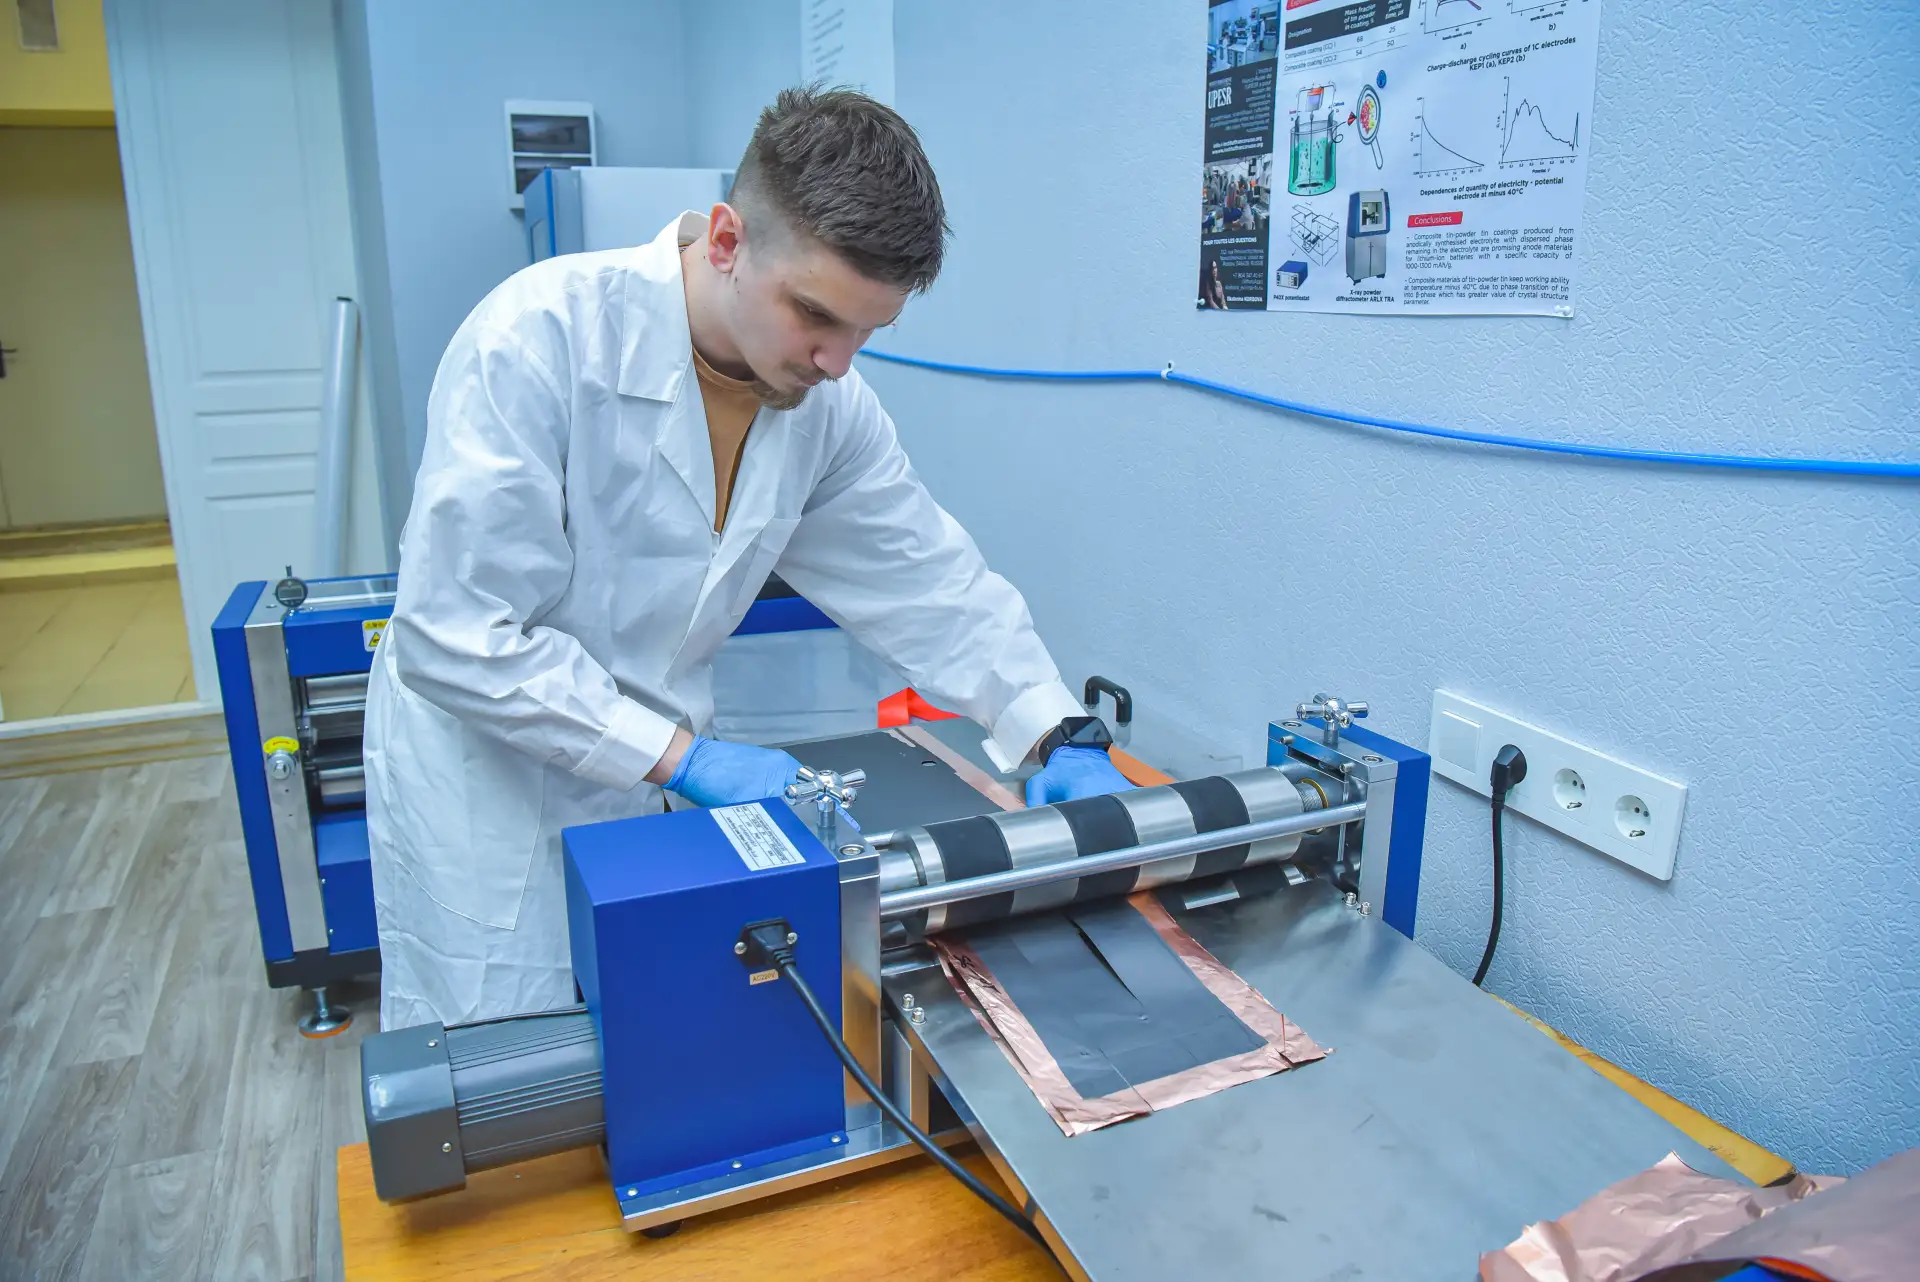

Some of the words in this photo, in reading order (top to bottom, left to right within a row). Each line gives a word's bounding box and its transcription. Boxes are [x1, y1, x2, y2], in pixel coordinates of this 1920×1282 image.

[1358, 4, 1376, 13] fraction
[1359, 11, 1375, 20] powder
[1285, 50, 1306, 59] Composite
[1307, 46, 1322, 54] coating
[1427, 56, 1477, 72] Charge-discharge
[1479, 52, 1500, 62] cycling
[1502, 48, 1522, 57] curves
[1532, 42, 1539, 51] 1C
[1541, 37, 1576, 49] electrodes
[1498, 56, 1514, 65] KEP2
[1516, 55, 1525, 63] (b)
[1285, 63, 1306, 71] Composite
[1307, 59, 1322, 67] coating
[1208, 86, 1232, 109] UPESR
[1420, 186, 1457, 196] Dependences
[1466, 184, 1488, 193] quantity
[1498, 180, 1528, 188] electricity
[1535, 177, 1563, 186] potential
[1415, 216, 1452, 224] Conclusions
[1524, 227, 1553, 235] produced
[1533, 252, 1559, 260] capacity
[1525, 276, 1549, 284] working
[1551, 276, 1569, 285] ability
[1541, 292, 1568, 300] structure
